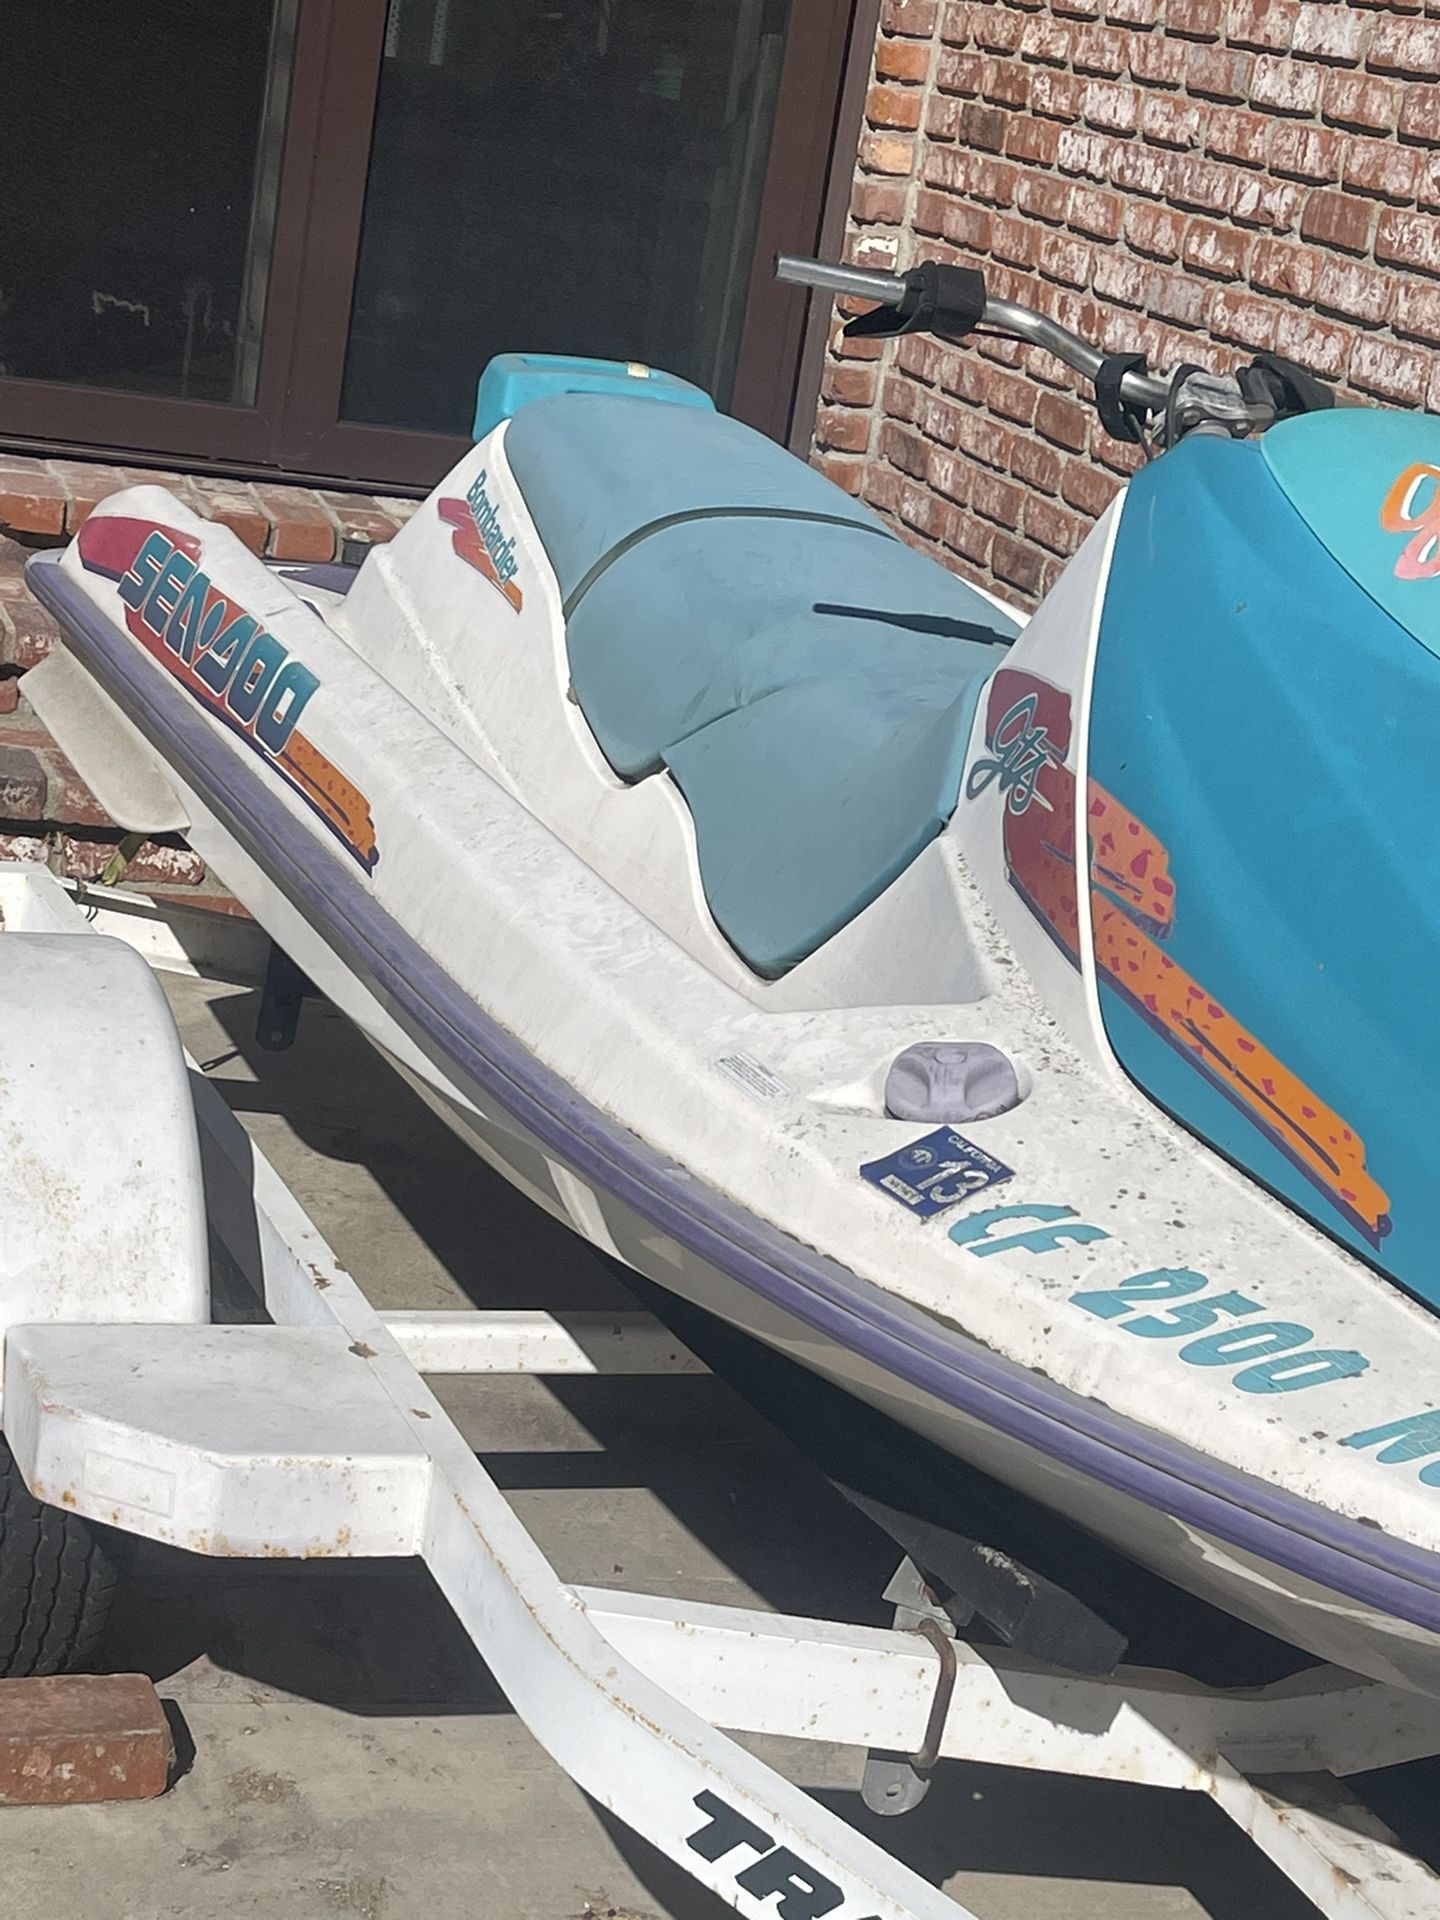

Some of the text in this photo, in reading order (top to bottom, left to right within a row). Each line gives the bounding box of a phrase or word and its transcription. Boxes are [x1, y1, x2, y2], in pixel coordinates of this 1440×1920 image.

[466, 469, 519, 583] Bombardier
[913, 1160, 990, 1204] 13
[948, 1203, 1112, 1258] CF
[1067, 1267, 1371, 1394] 2500
[685, 1788, 882, 1920] TR
